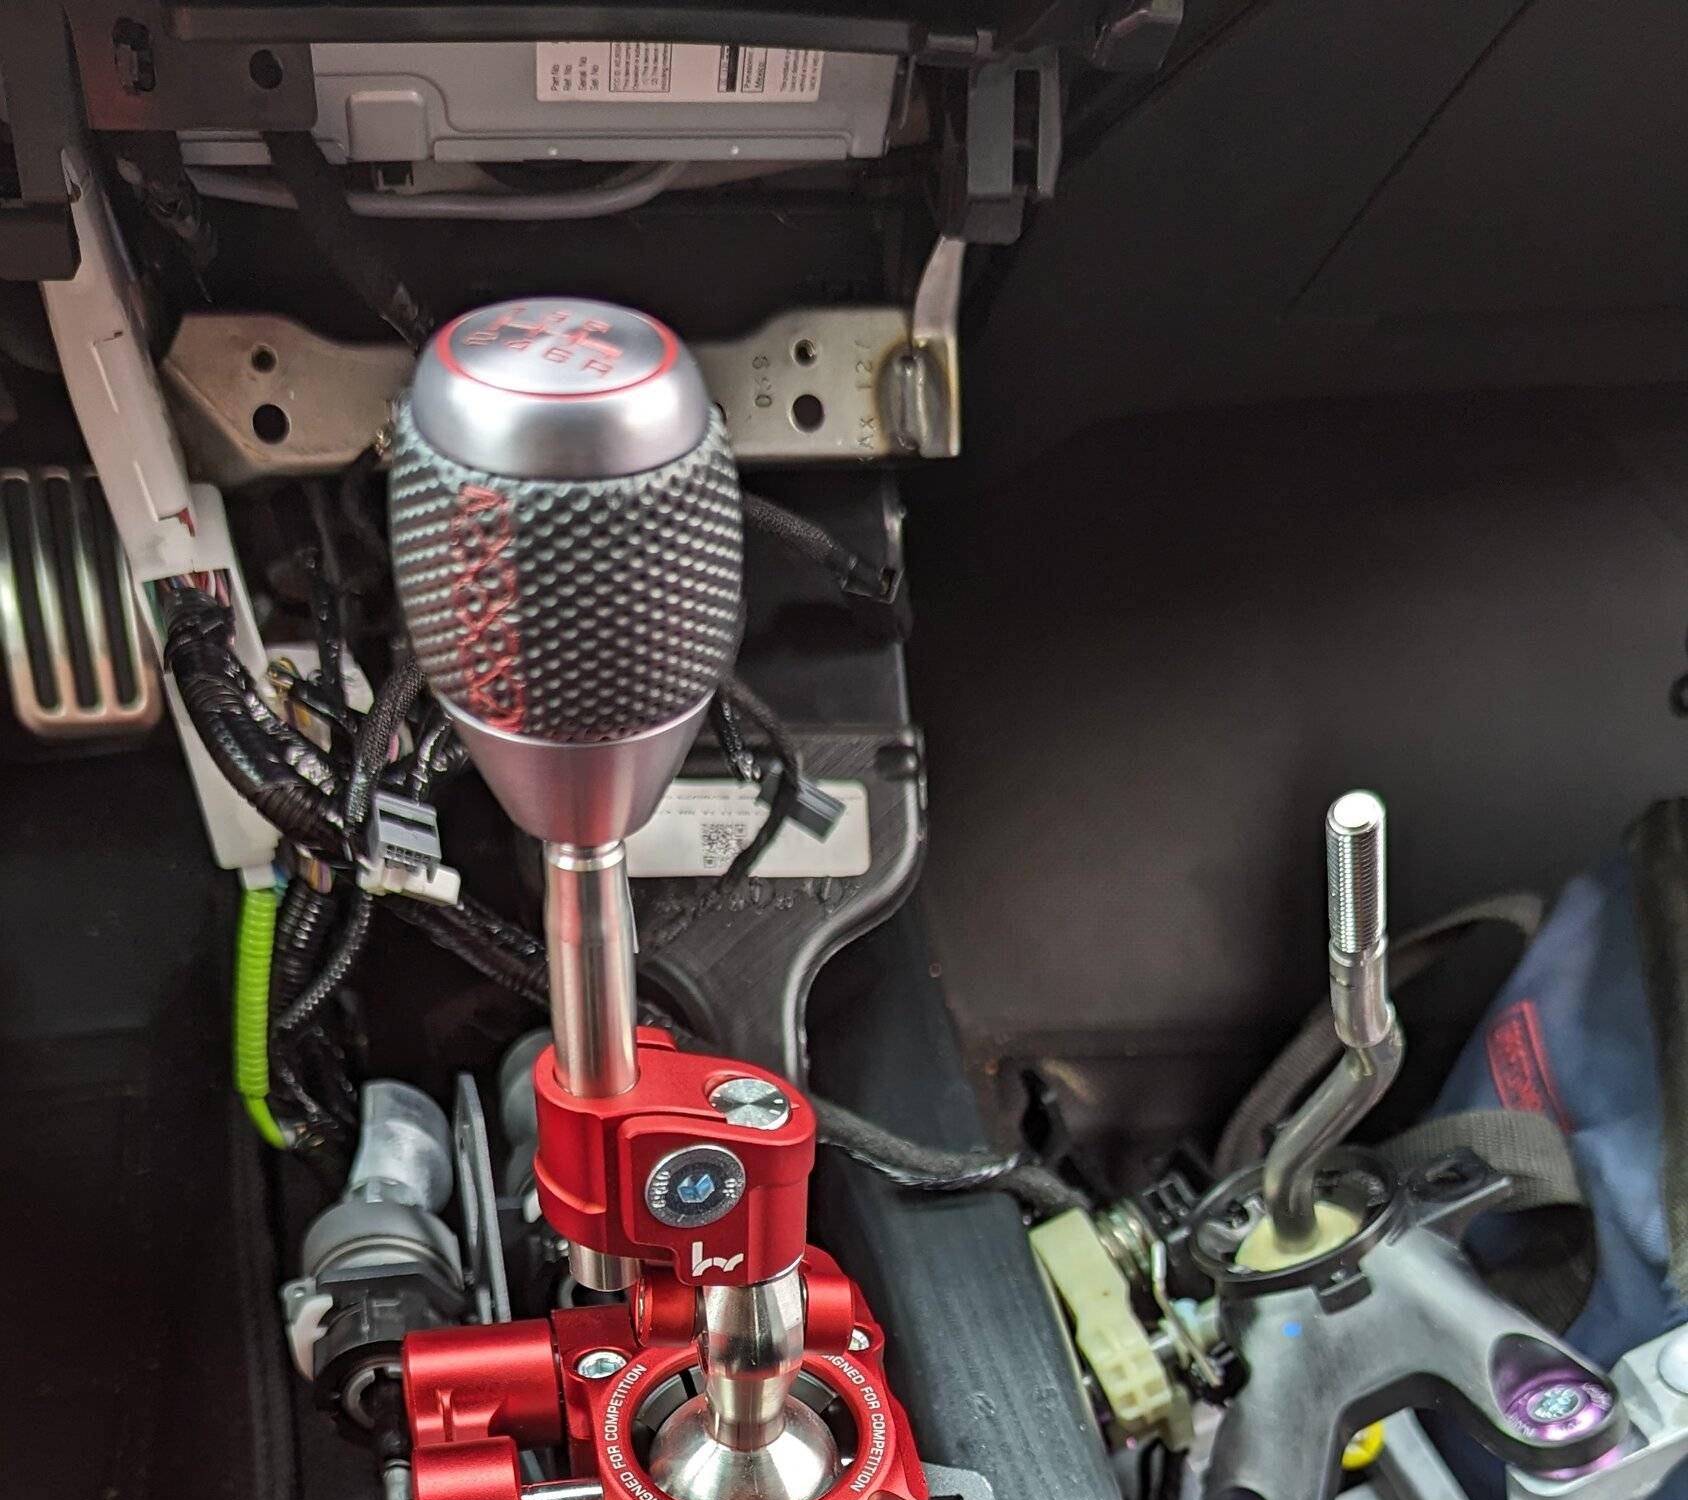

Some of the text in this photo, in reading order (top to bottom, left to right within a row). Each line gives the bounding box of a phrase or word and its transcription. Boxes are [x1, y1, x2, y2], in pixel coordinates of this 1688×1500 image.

[605, 1364, 647, 1441] COMPETITION
[860, 1386, 881, 1410] FOR
[607, 1445, 626, 1470] FOR
[850, 1413, 886, 1493] COMPETITION
